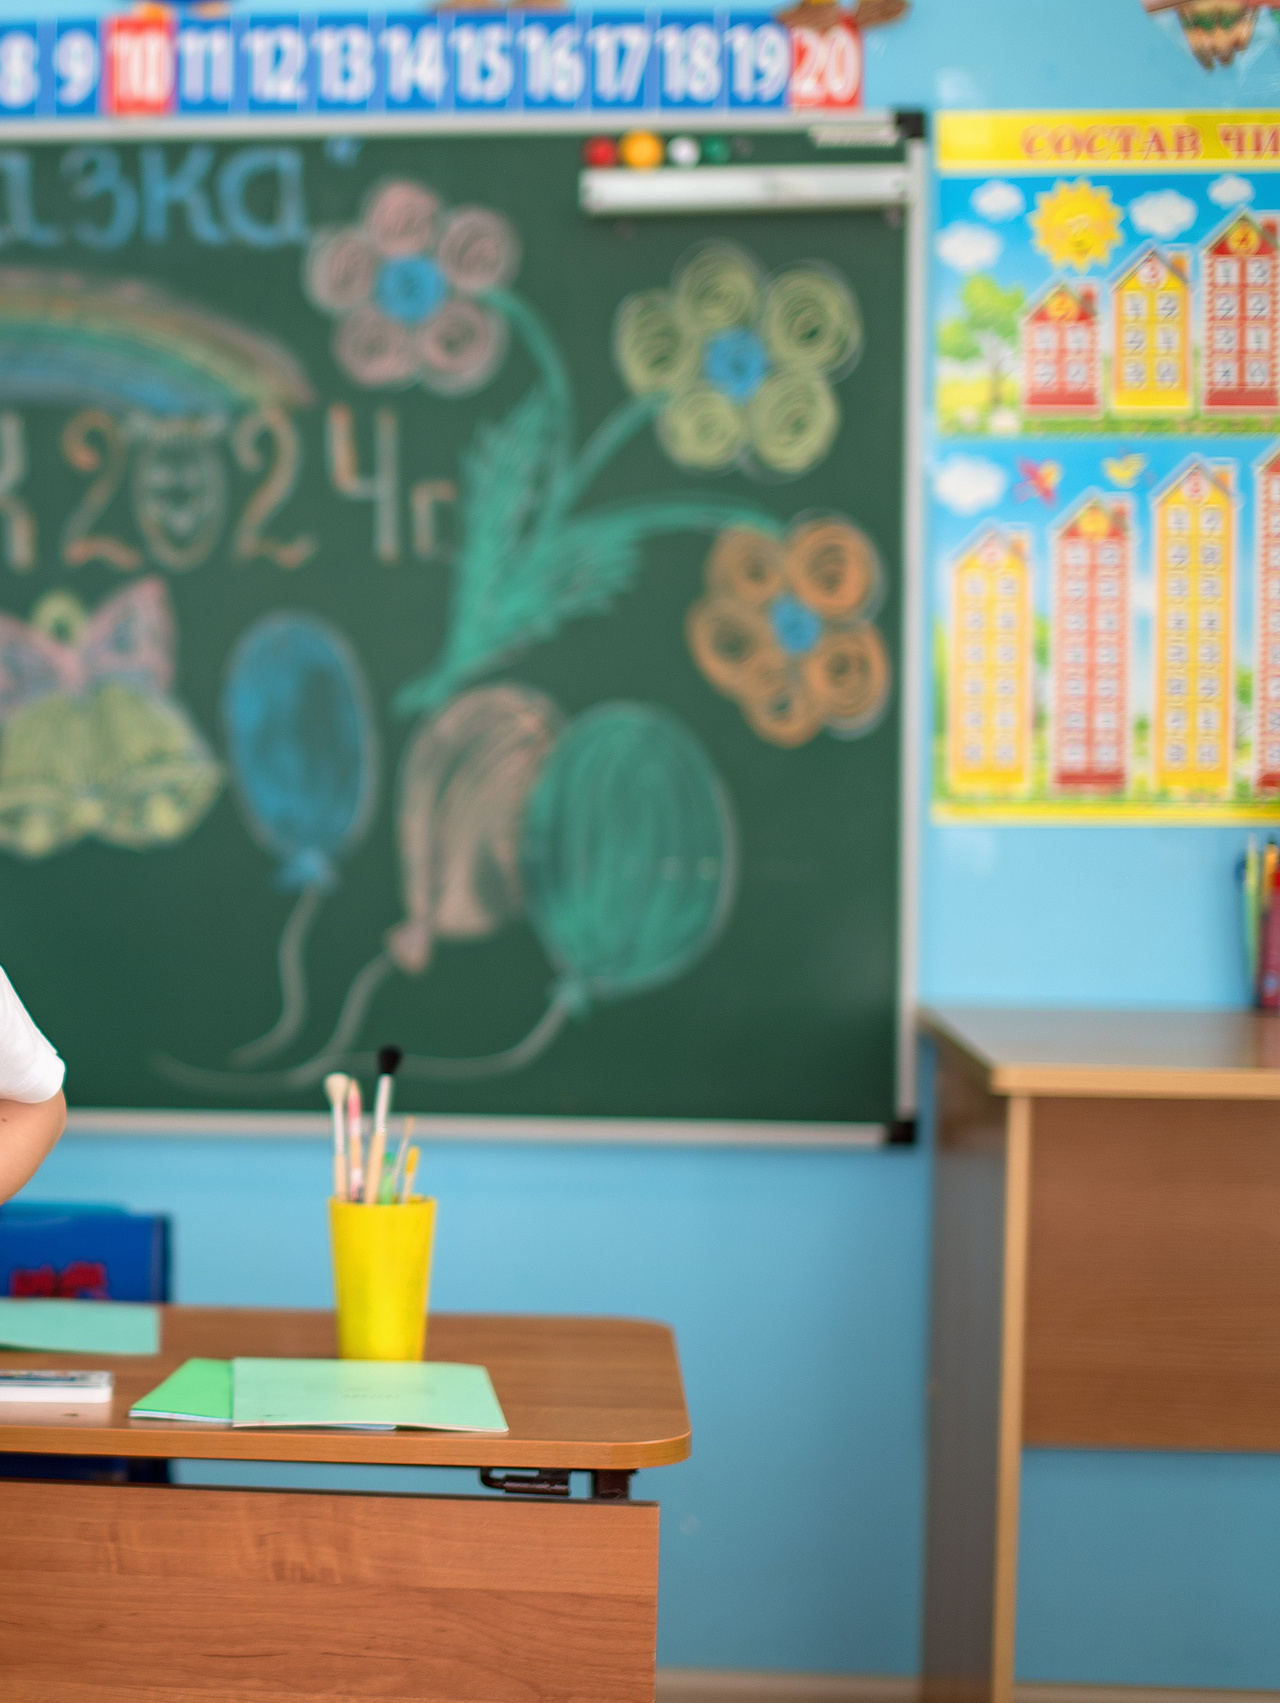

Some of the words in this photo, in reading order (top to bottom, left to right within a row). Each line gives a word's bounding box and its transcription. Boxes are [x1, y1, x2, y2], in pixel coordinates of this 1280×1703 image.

[53, 30, 97, 107] 9
[108, 30, 173, 106] 10
[178, 25, 231, 102] 11
[242, 25, 306, 101] 12
[313, 24, 373, 101] 13
[379, 24, 445, 101] 14
[450, 24, 514, 101] 15
[520, 24, 584, 101] 16
[587, 24, 651, 101] 17
[657, 24, 721, 100] 18
[724, 24, 788, 100] 19
[793, 22, 860, 102] 20
[1020, 124, 1204, 161] СОСТАВ
